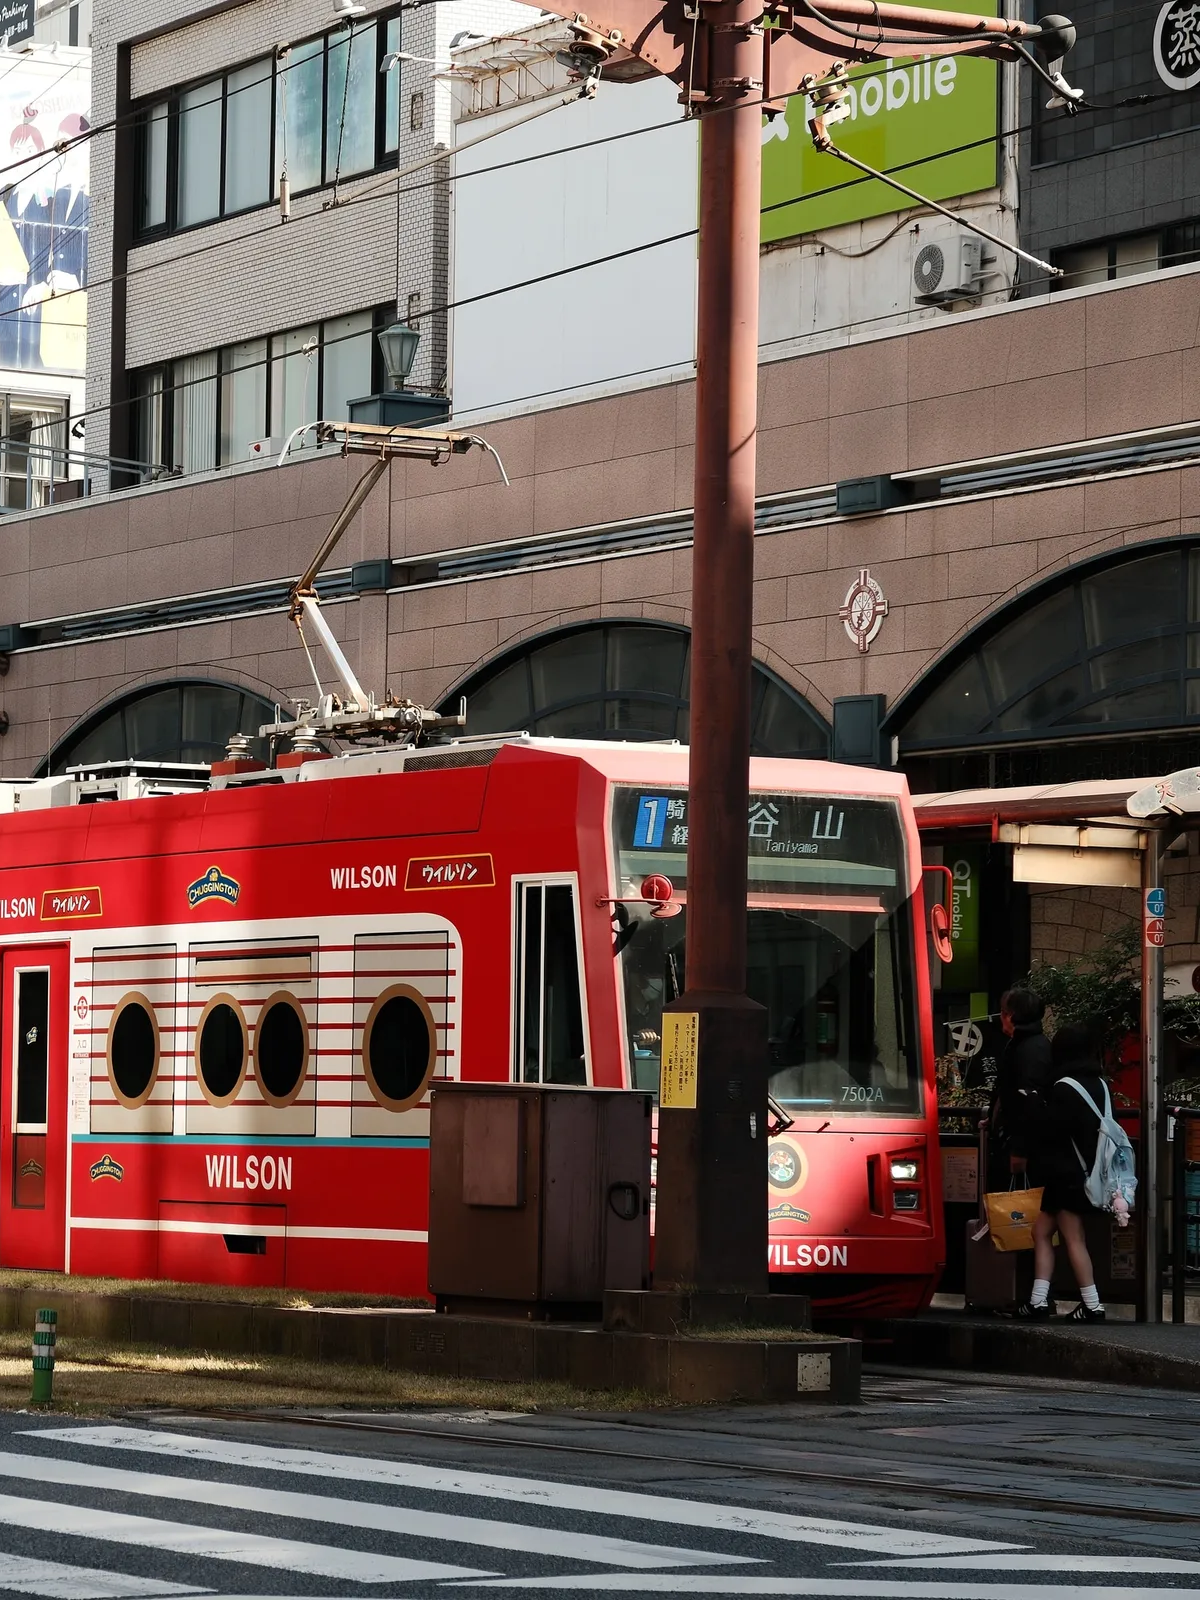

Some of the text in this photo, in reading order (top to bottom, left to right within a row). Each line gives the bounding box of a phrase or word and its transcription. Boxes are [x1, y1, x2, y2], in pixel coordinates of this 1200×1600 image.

[666, 800, 687, 820] 騎
[644, 800, 659, 844] 1
[671, 825, 688, 846] 経
[765, 839, 819, 854] Taniyama
[330, 865, 397, 890] WILSON
[421, 862, 478, 883] ウィルソン
[189, 882, 238, 902] CHUGGINGTON
[952, 860, 972, 939] QT mobile
[52, 894, 91, 913] ウィルソン
[1156, 921, 1163, 931] N
[841, 1086, 884, 1102] 7502A
[90, 1165, 123, 1179] CHUGGINGTON
[205, 1155, 292, 1190] WILSON
[768, 1211, 810, 1221] HUGGINGTON
[767, 1244, 848, 1267] ILSON
